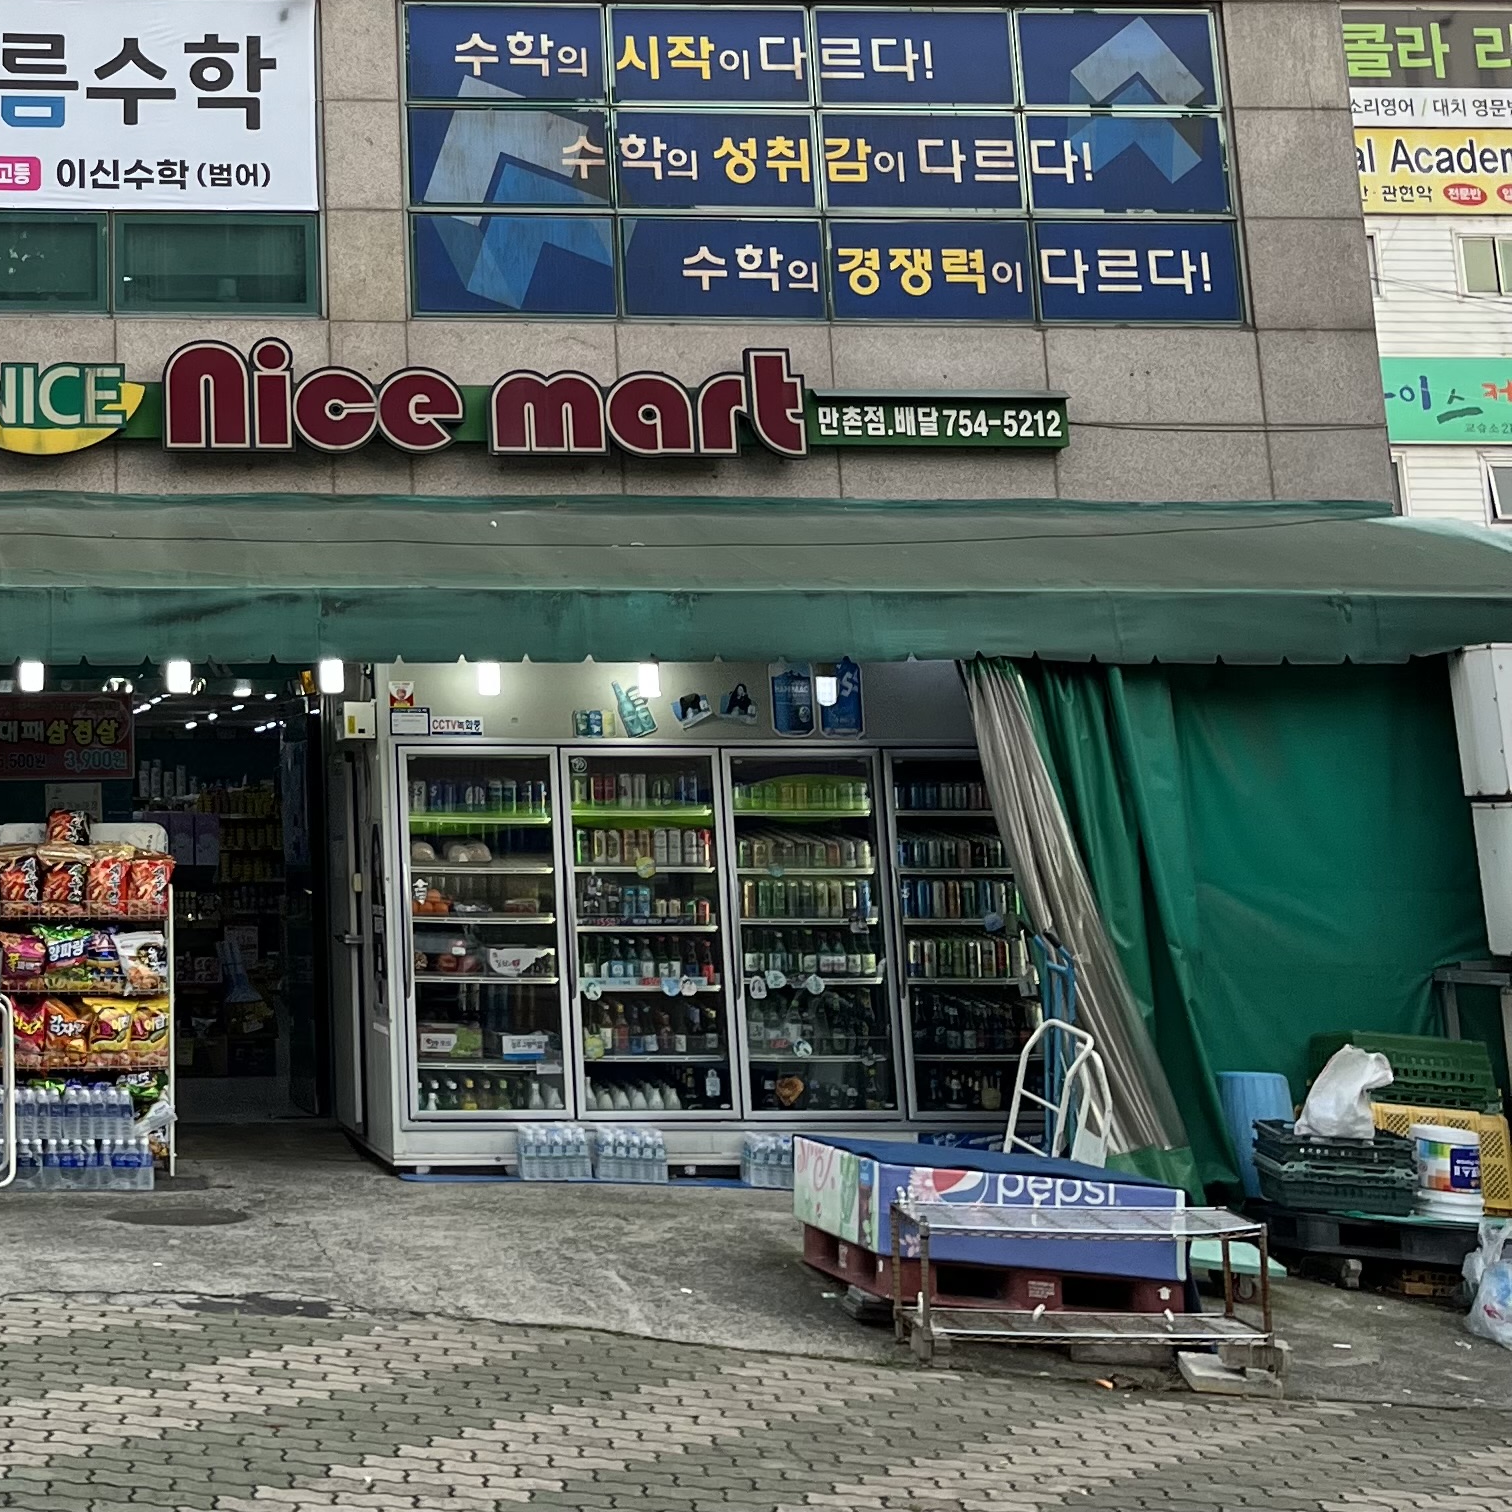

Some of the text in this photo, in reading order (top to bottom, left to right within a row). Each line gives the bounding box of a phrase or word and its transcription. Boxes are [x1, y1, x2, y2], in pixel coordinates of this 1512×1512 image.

[454, 31, 934, 82] 수학의 시작이 다르다!
[561, 135, 1093, 184] 수학의 성취감이 다르다!
[682, 243, 1213, 296] 수학의 경쟁력이 다르다!
[489, 348, 807, 459] mart
[942, 409, 1062, 437] 754-5212
